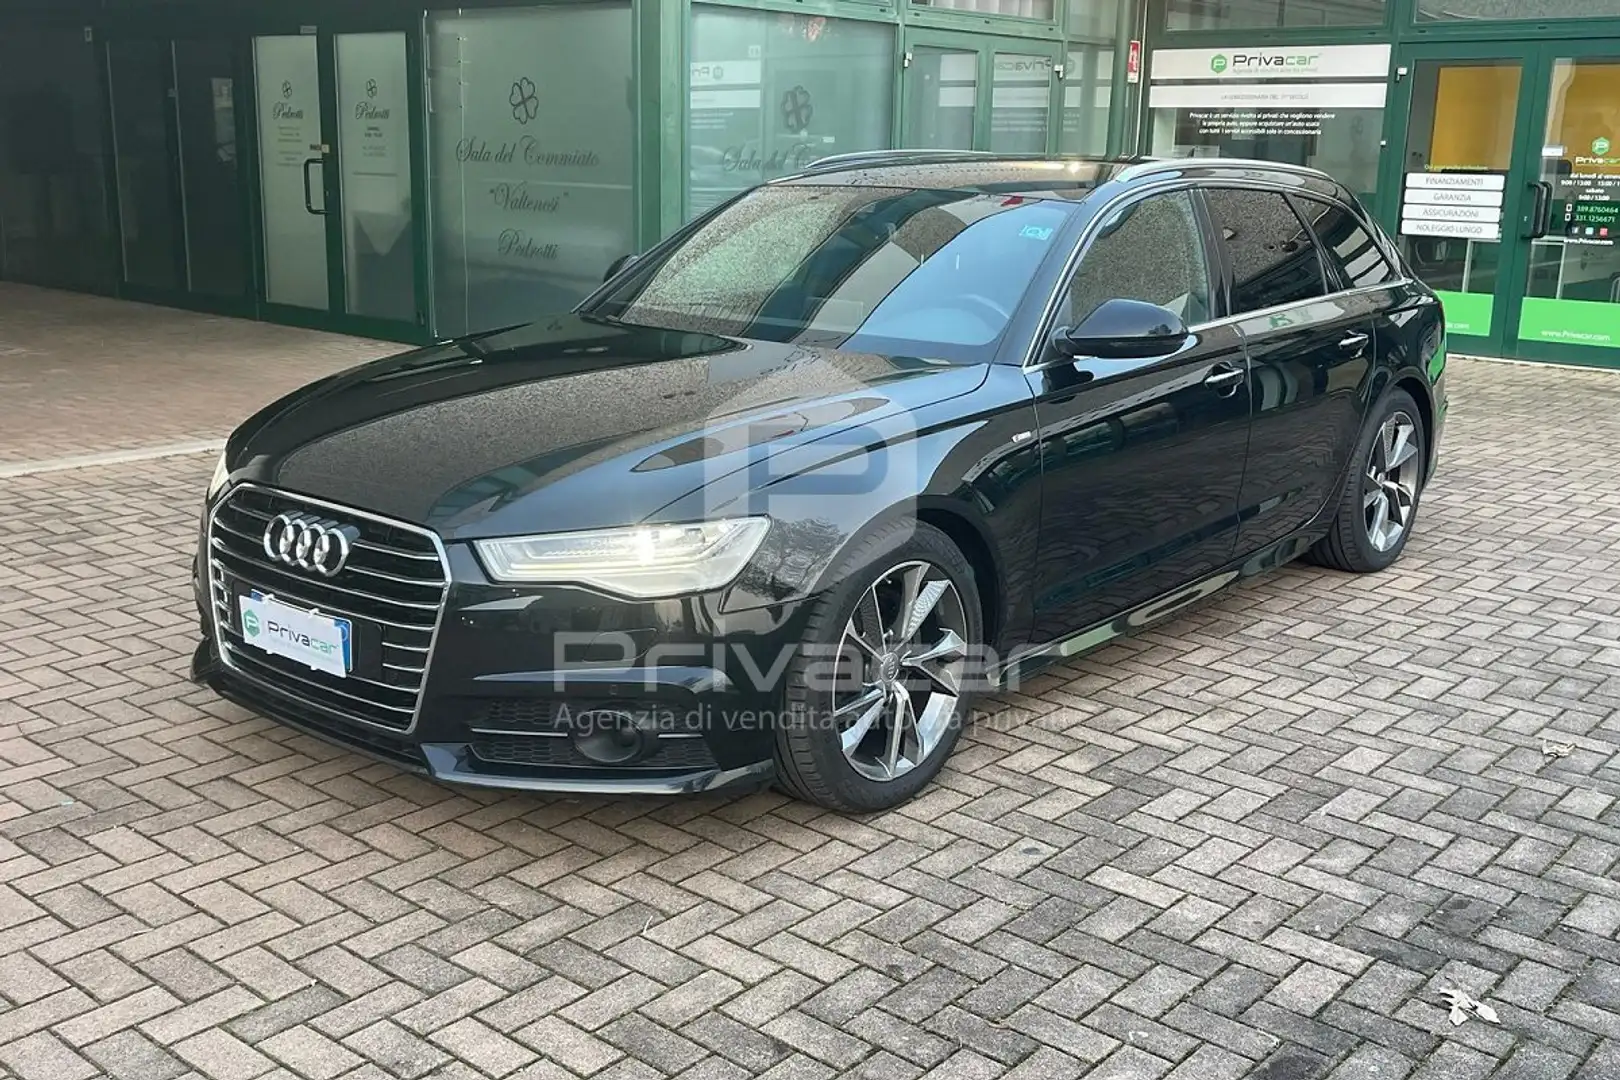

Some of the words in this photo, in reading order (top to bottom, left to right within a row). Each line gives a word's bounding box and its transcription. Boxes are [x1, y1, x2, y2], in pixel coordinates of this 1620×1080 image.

[1232, 52, 1319, 67] Privacar
[456, 136, 494, 163] Sala
[494, 143, 517, 163] del
[1425, 177, 1484, 186] FINANZIAMENTI
[1433, 194, 1472, 202] GARANZIA
[1422, 208, 1480, 218] ASSICURAZIONI
[1455, 225, 1482, 234] LUNGO
[267, 620, 338, 654] Privacar
